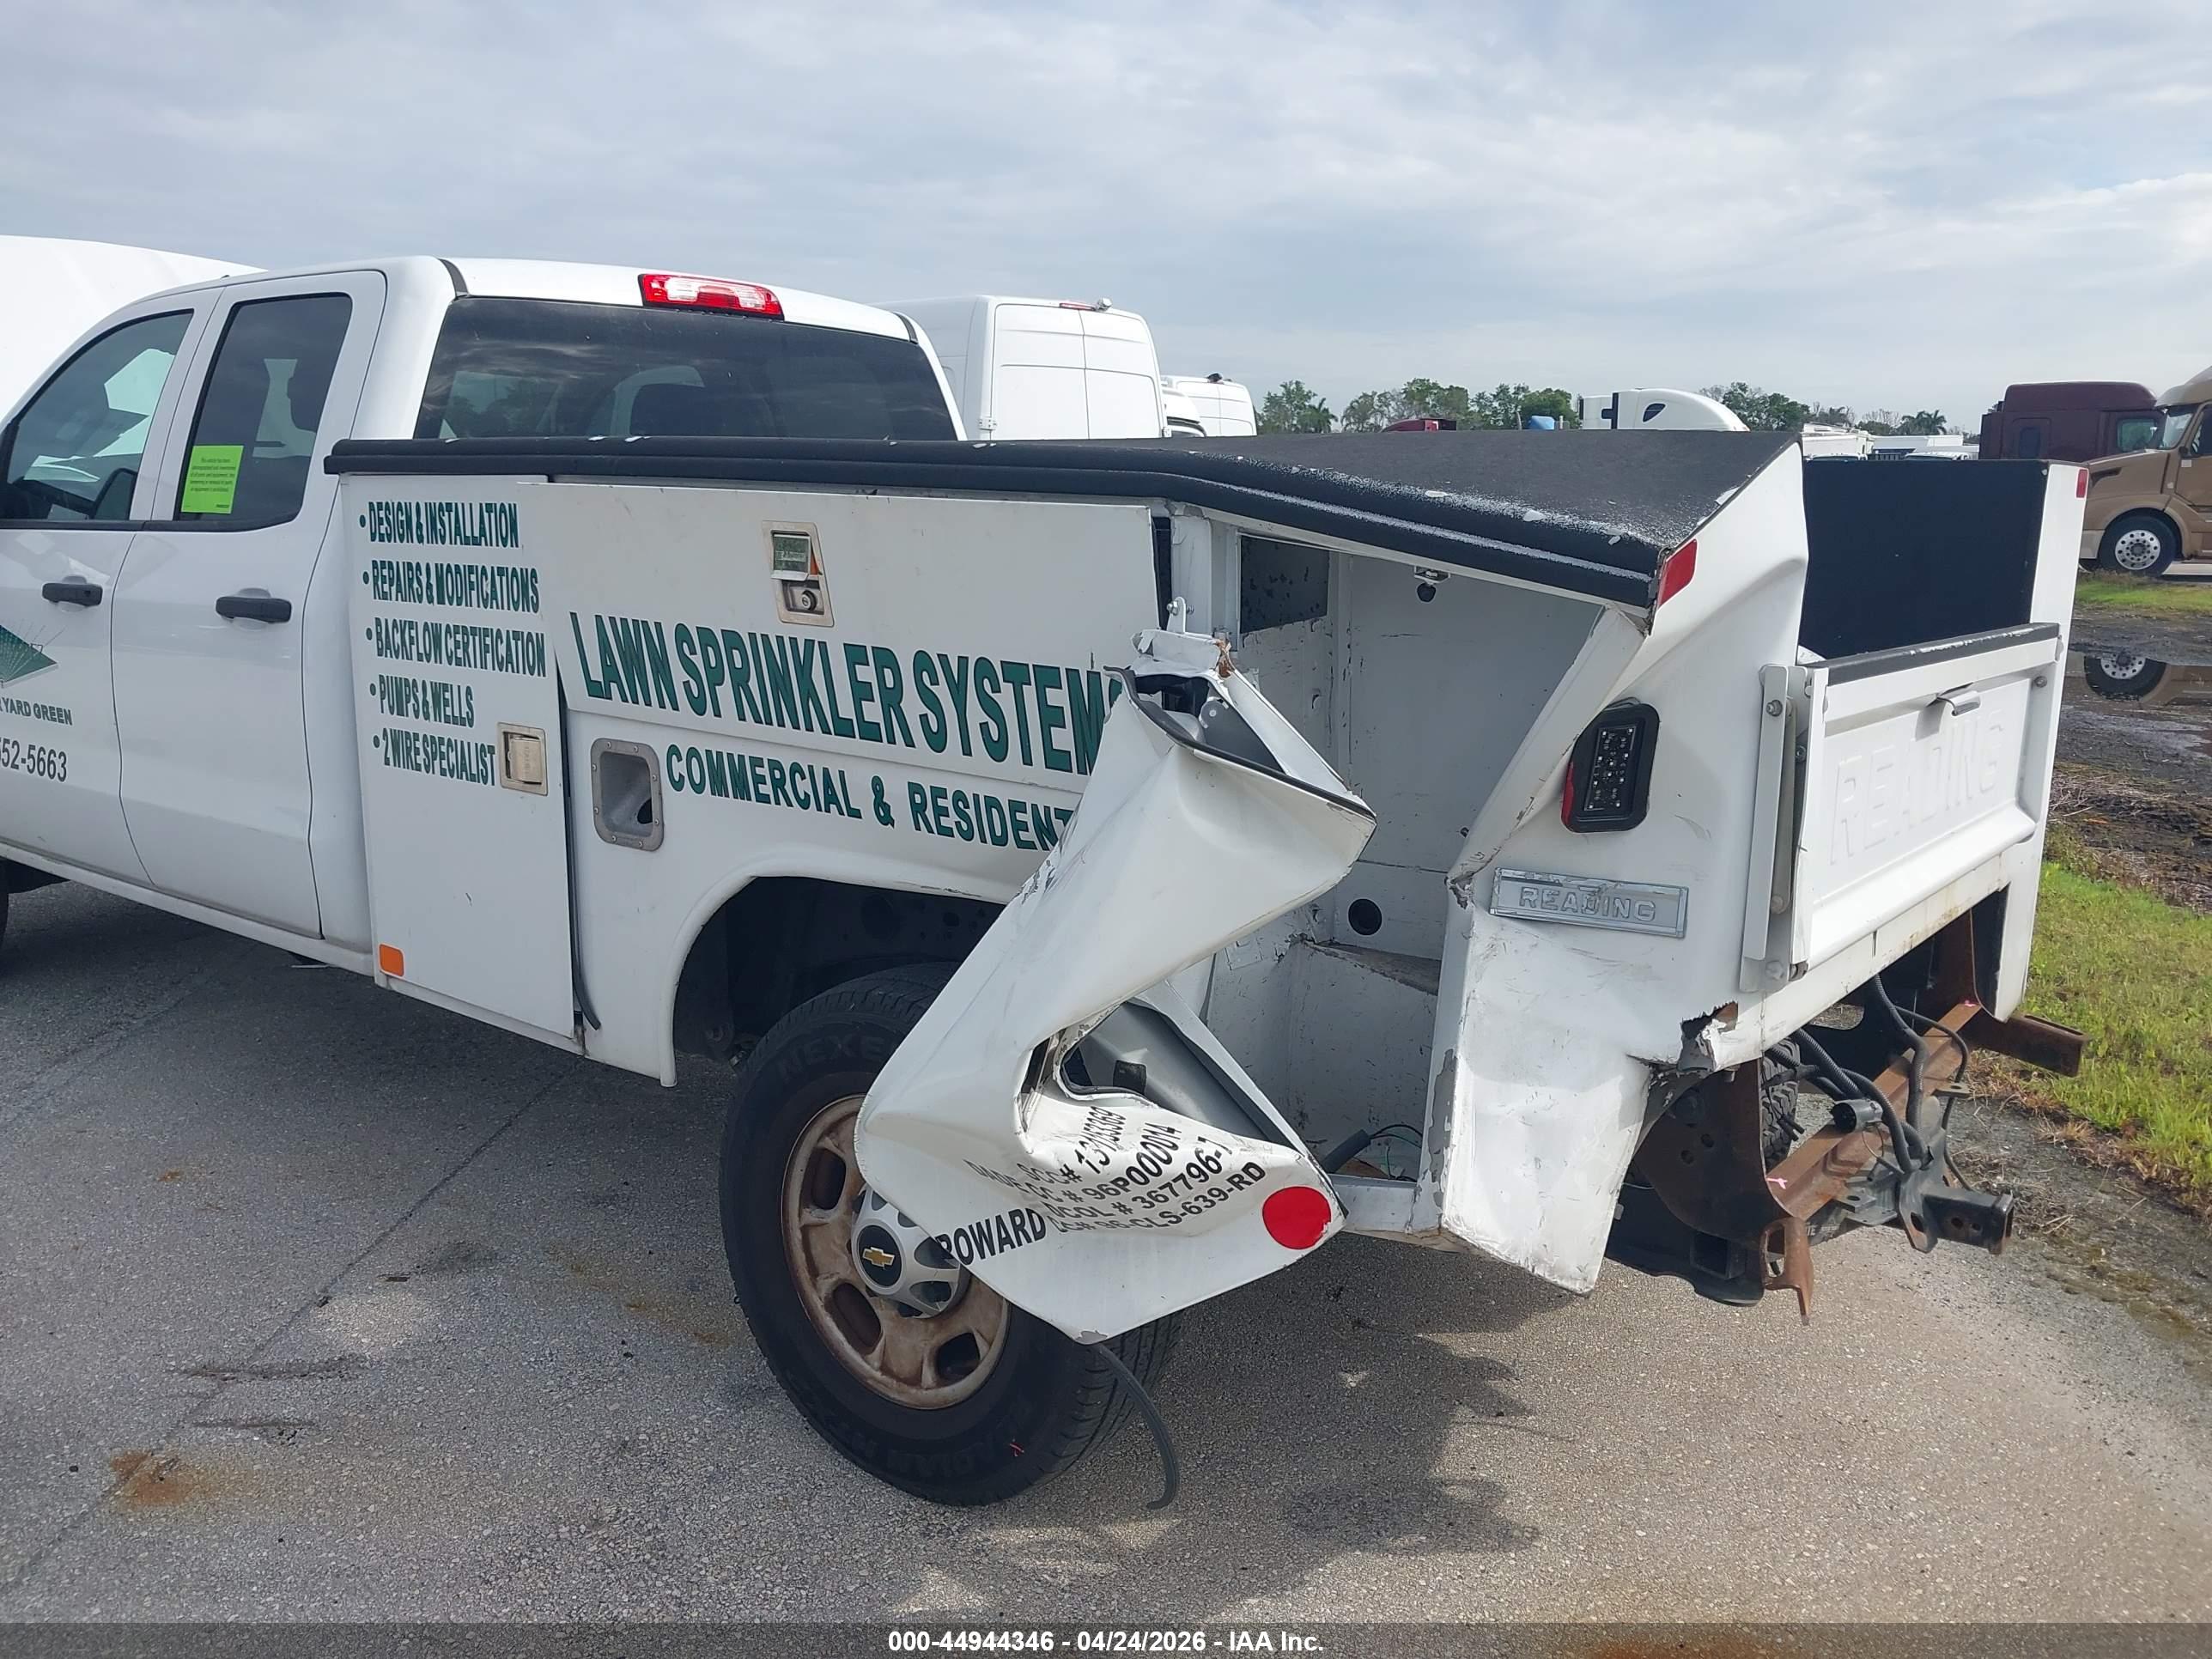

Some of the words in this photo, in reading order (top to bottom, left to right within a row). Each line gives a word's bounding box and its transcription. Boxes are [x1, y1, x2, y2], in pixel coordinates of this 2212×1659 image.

[368, 501, 414, 544] DESIGN
[416, 501, 424, 545] &
[424, 502, 519, 548] INSTALLATION
[372, 560, 423, 604] REPAIRS
[426, 562, 434, 605] &
[434, 563, 539, 613] MODIFICATIONS
[374, 617, 443, 665] BACKFLOW
[445, 623, 546, 678] CERTIFICATION
[379, 674, 420, 720] PUMPS
[422, 680, 430, 721] &
[430, 681, 474, 728] WELLS
[569, 611, 680, 712] LAWN
[675, 623, 916, 748] SPRINKLER
[2, 697, 32, 717] YARD
[33, 703, 72, 726] GREEN
[0, 737, 67, 782] 52-5663
[382, 728, 390, 766] 2
[390, 728, 422, 772] WIRE
[422, 733, 495, 786] SPECIALIST
[666, 744, 863, 819] COMMERCIAL
[871, 775, 895, 829] &
[1519, 886, 1656, 921] READING
[1111, 1201, 1133, 1215] #
